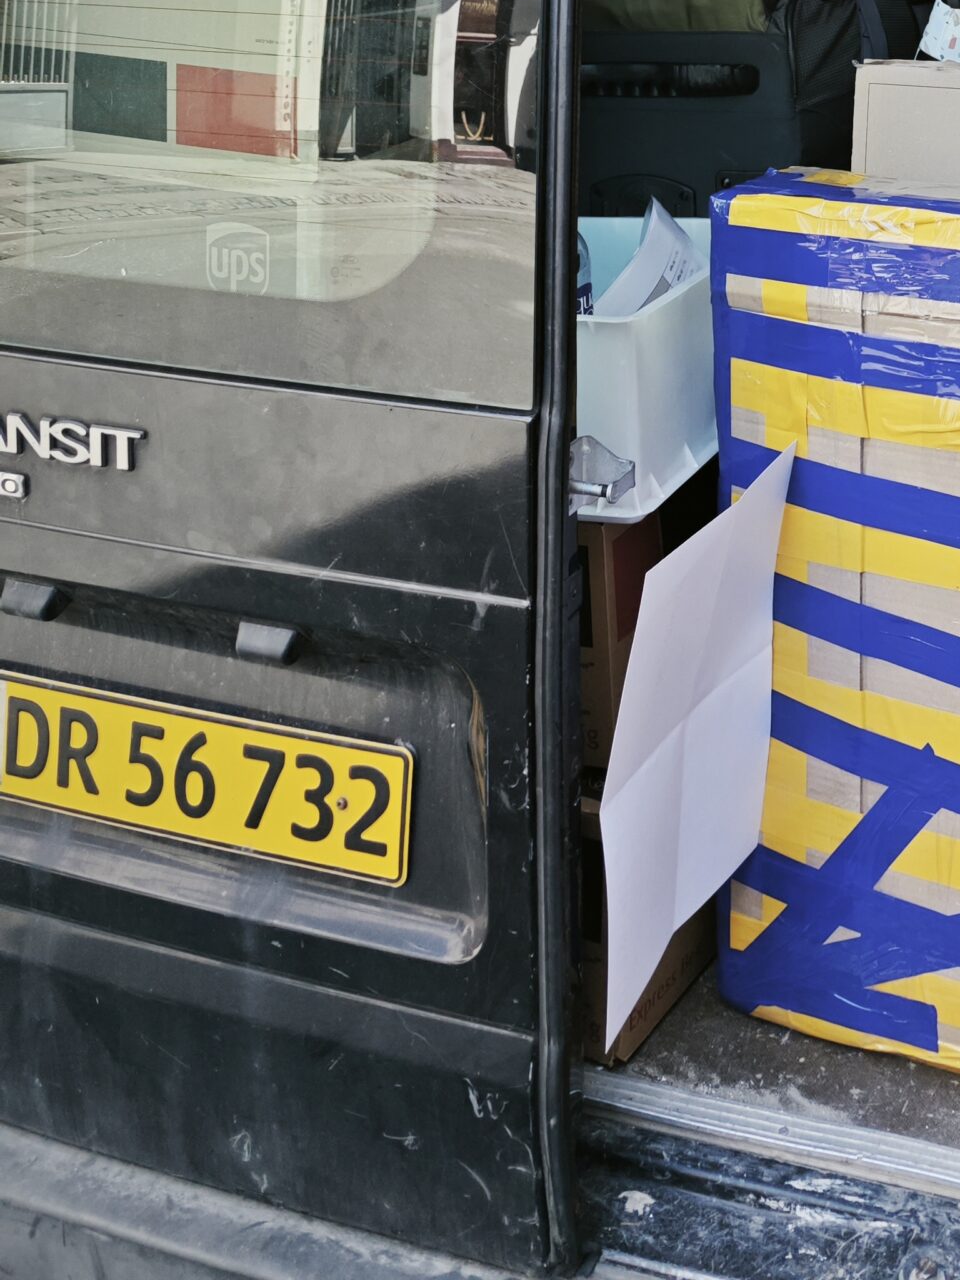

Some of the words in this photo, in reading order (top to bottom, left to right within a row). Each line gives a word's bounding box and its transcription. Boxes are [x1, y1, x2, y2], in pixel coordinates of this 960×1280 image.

[0, 412, 146, 471] NSIT
[125, 720, 216, 820] 56
[242, 743, 390, 858] 732
